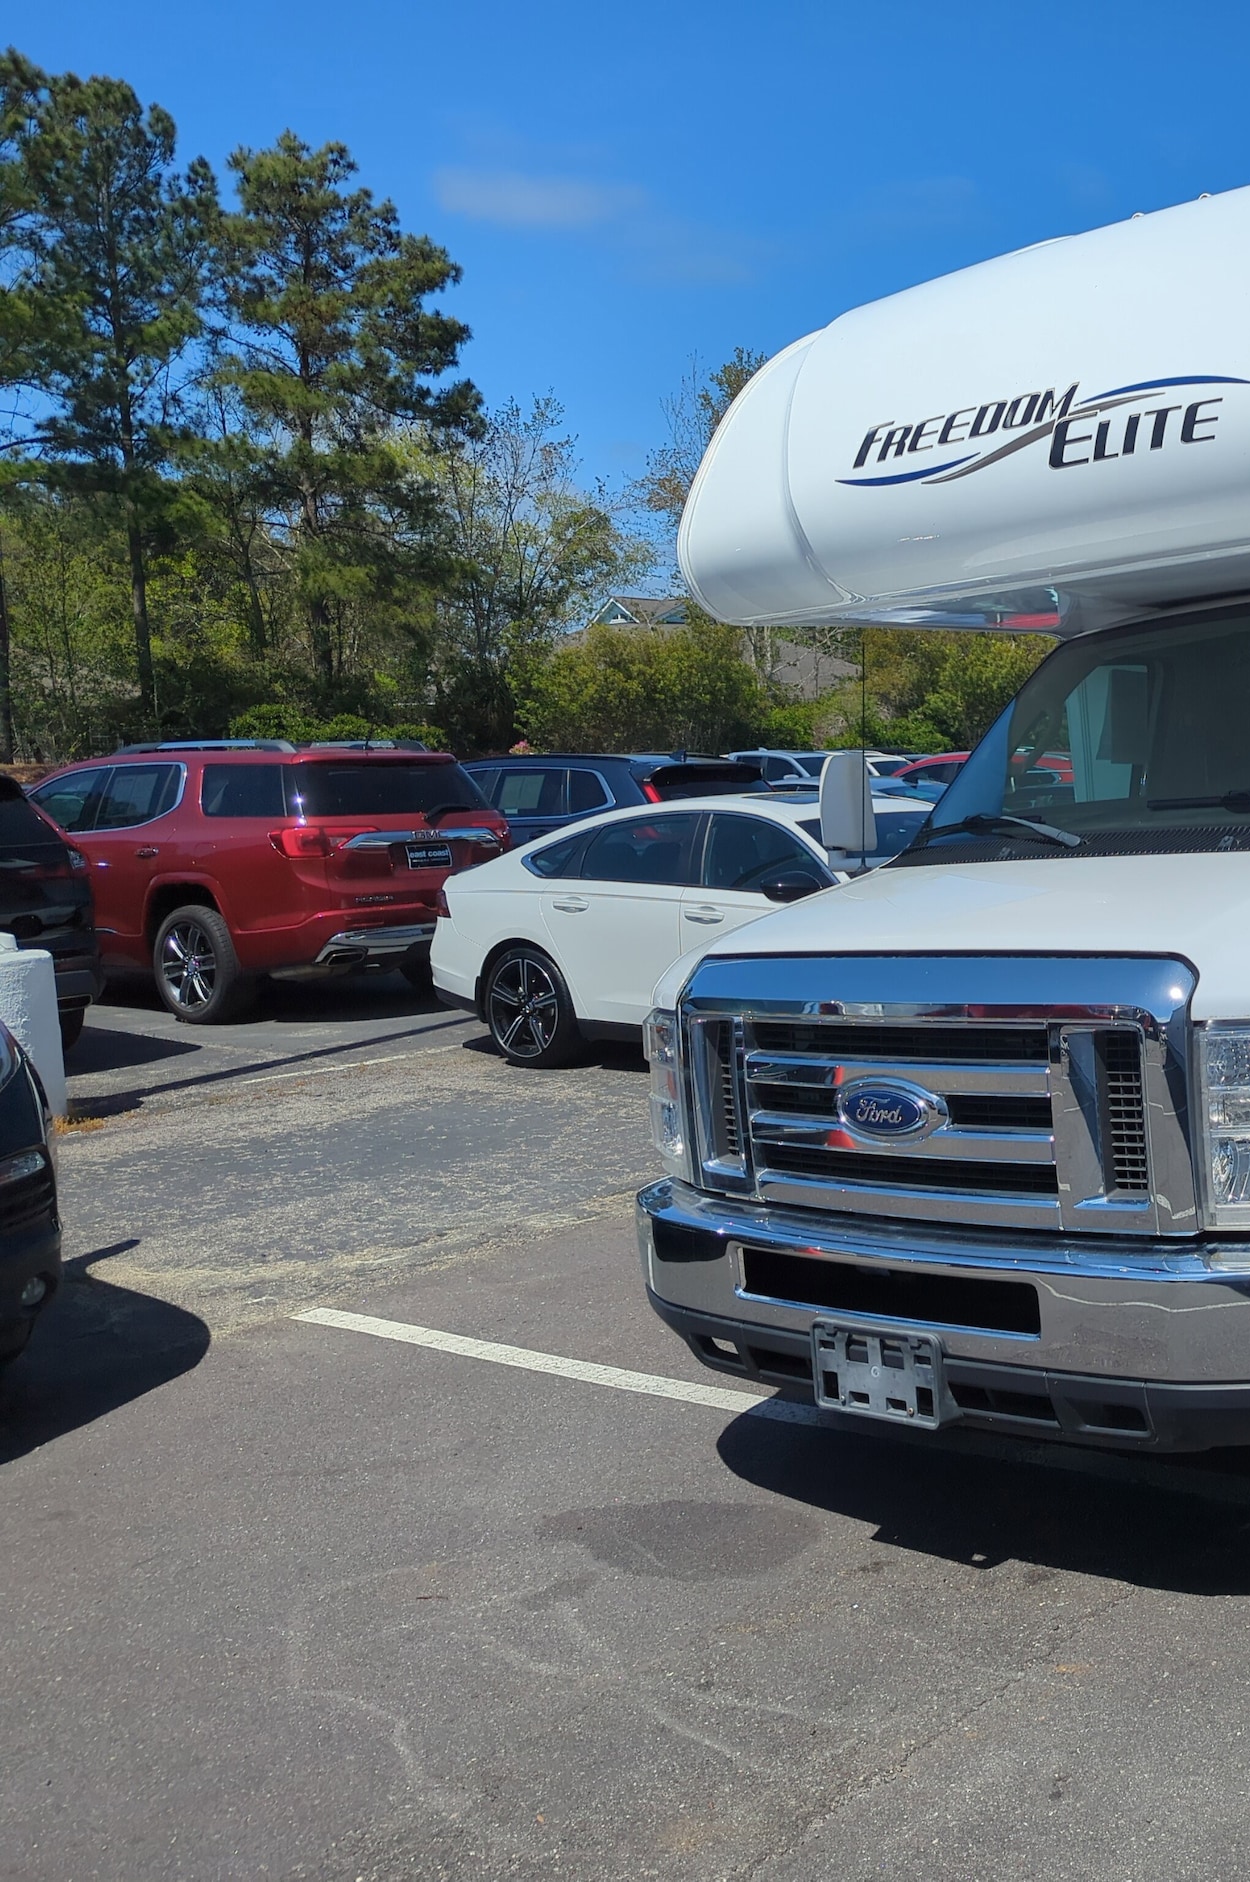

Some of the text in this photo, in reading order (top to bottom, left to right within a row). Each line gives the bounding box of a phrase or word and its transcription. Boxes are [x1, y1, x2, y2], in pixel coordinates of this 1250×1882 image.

[852, 381, 1080, 469] FREEDOM
[1048, 397, 1223, 470] ELITE
[855, 1096, 902, 1124] Ford
